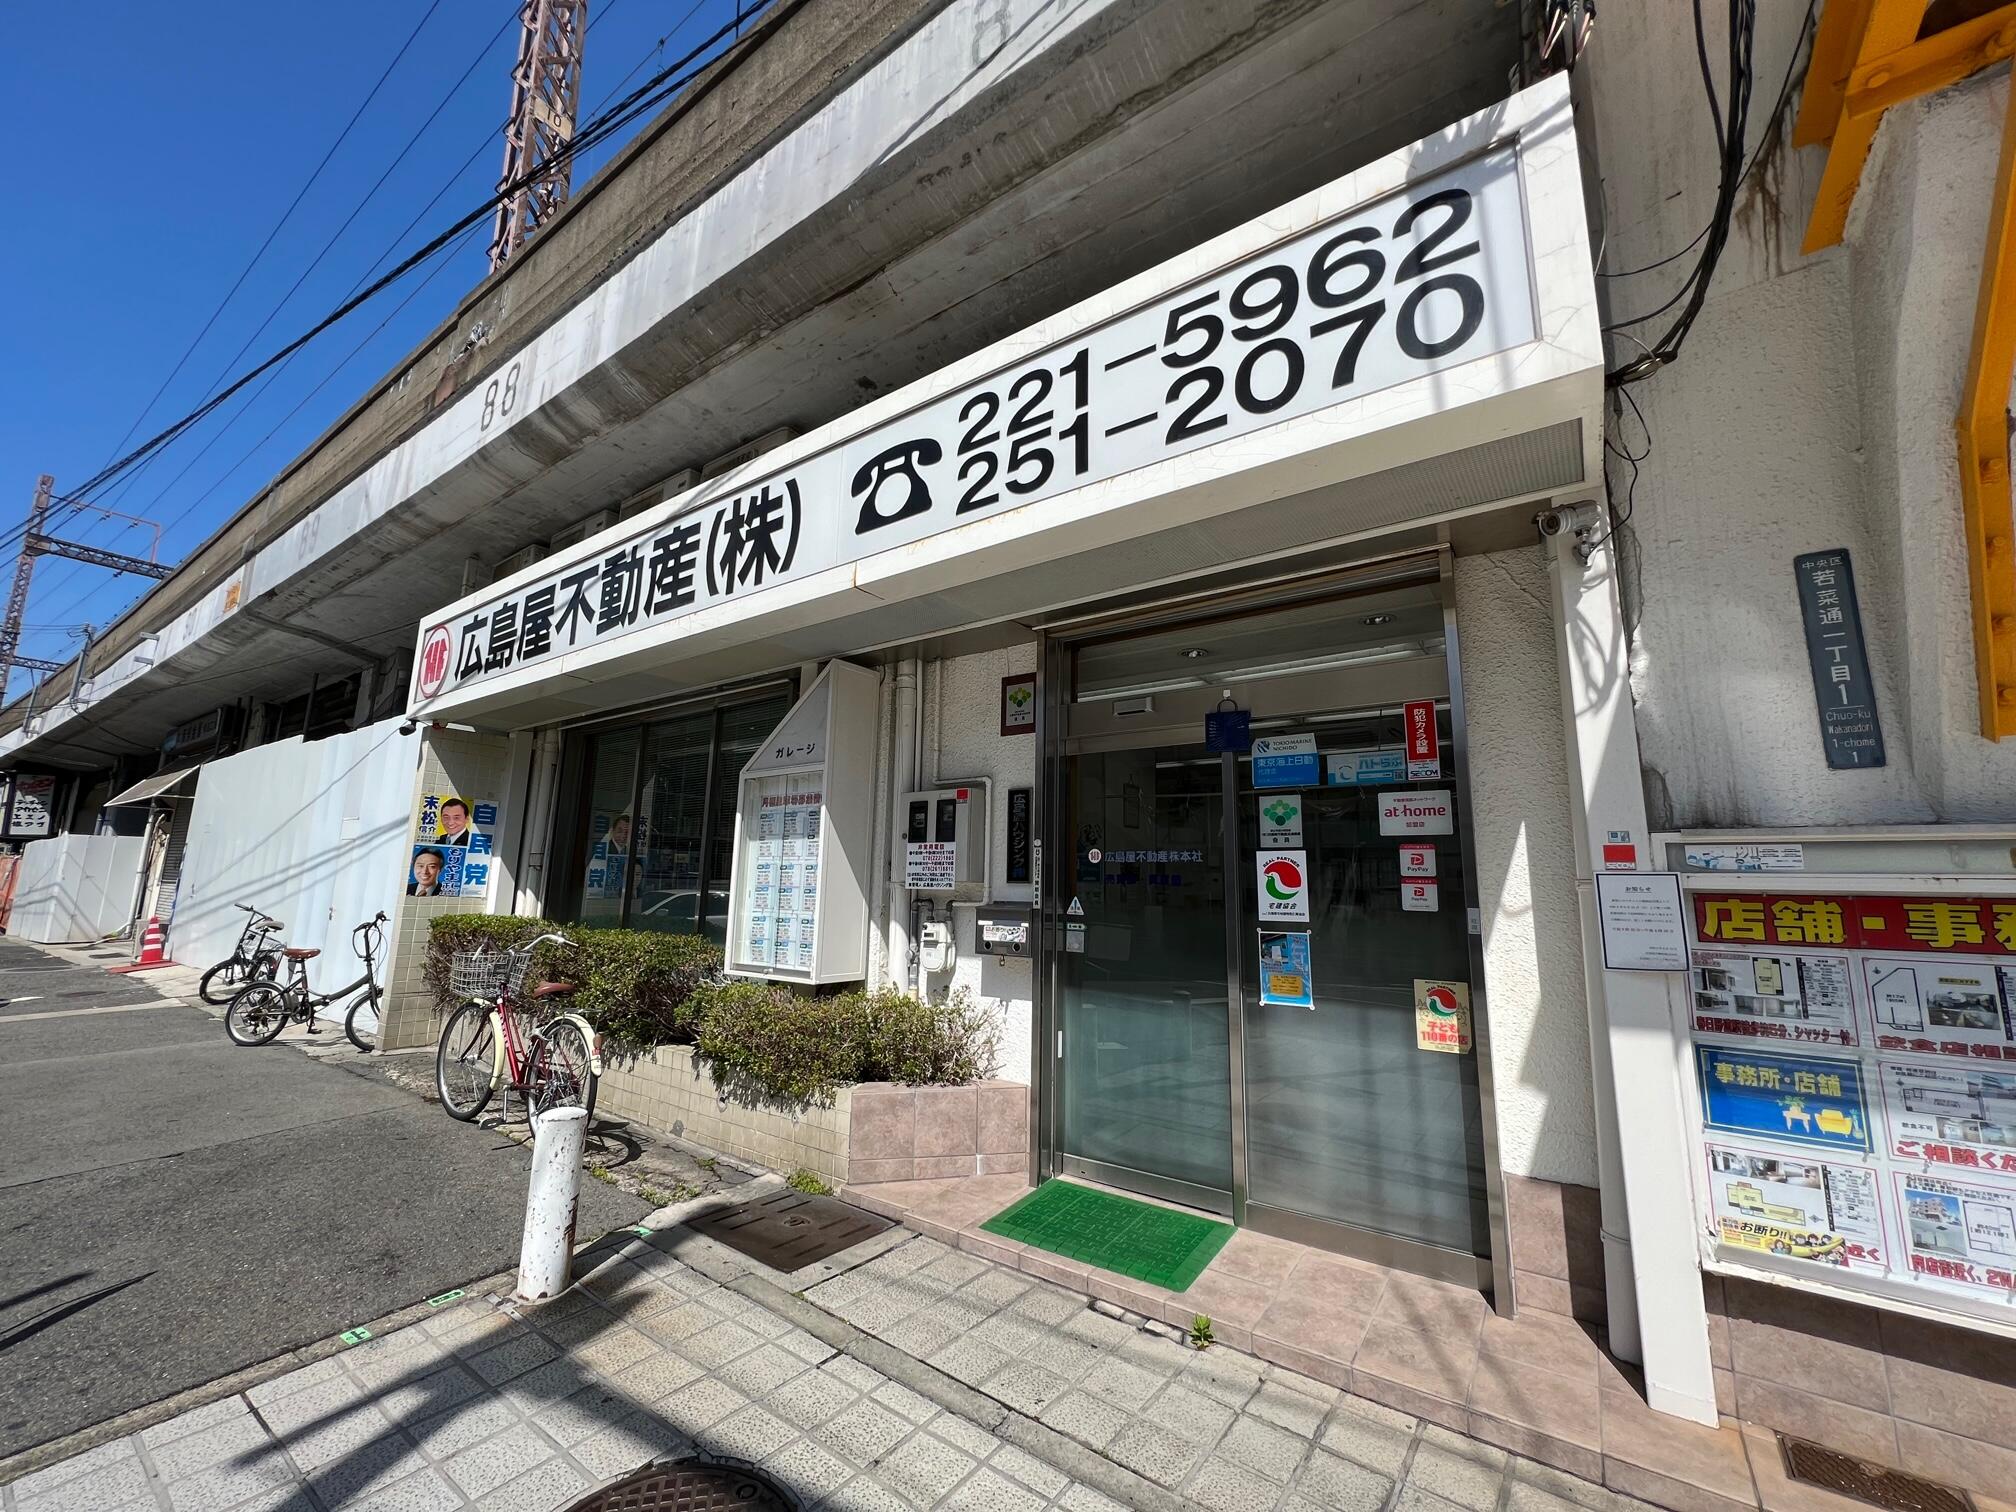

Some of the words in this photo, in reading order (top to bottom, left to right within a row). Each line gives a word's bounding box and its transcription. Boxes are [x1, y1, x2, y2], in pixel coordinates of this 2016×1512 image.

[957, 187, 1482, 456] 221-5962
[481, 361, 522, 432] 88
[955, 271, 1486, 517] 251-2070
[1801, 556, 1843, 570] 中央区
[454, 478, 802, 682] 広島屋不動産(株)
[1825, 709, 1872, 722] Chuo-ku
[1413, 708, 1429, 754] 防犯カメラ設置
[1827, 723, 1874, 735] Wakanadori
[1832, 737, 1876, 749] 1-chome
[775, 743, 816, 759] ガレージ
[1852, 751, 1859, 764] 1
[1257, 755, 1314, 768] 東京海上日動
[1410, 769, 1439, 777] SECOM
[1384, 805, 1400, 818] at
[1401, 804, 1446, 817] home
[464, 804, 498, 886] 自民党
[1625, 885, 1653, 893] お知らせ
[1426, 1020, 1459, 1034] 子ども
[1421, 1031, 1469, 1046] 110番の店
[1714, 1061, 1842, 1098] 事務所・店舗
[1740, 1221, 1788, 1241] お断り!!
